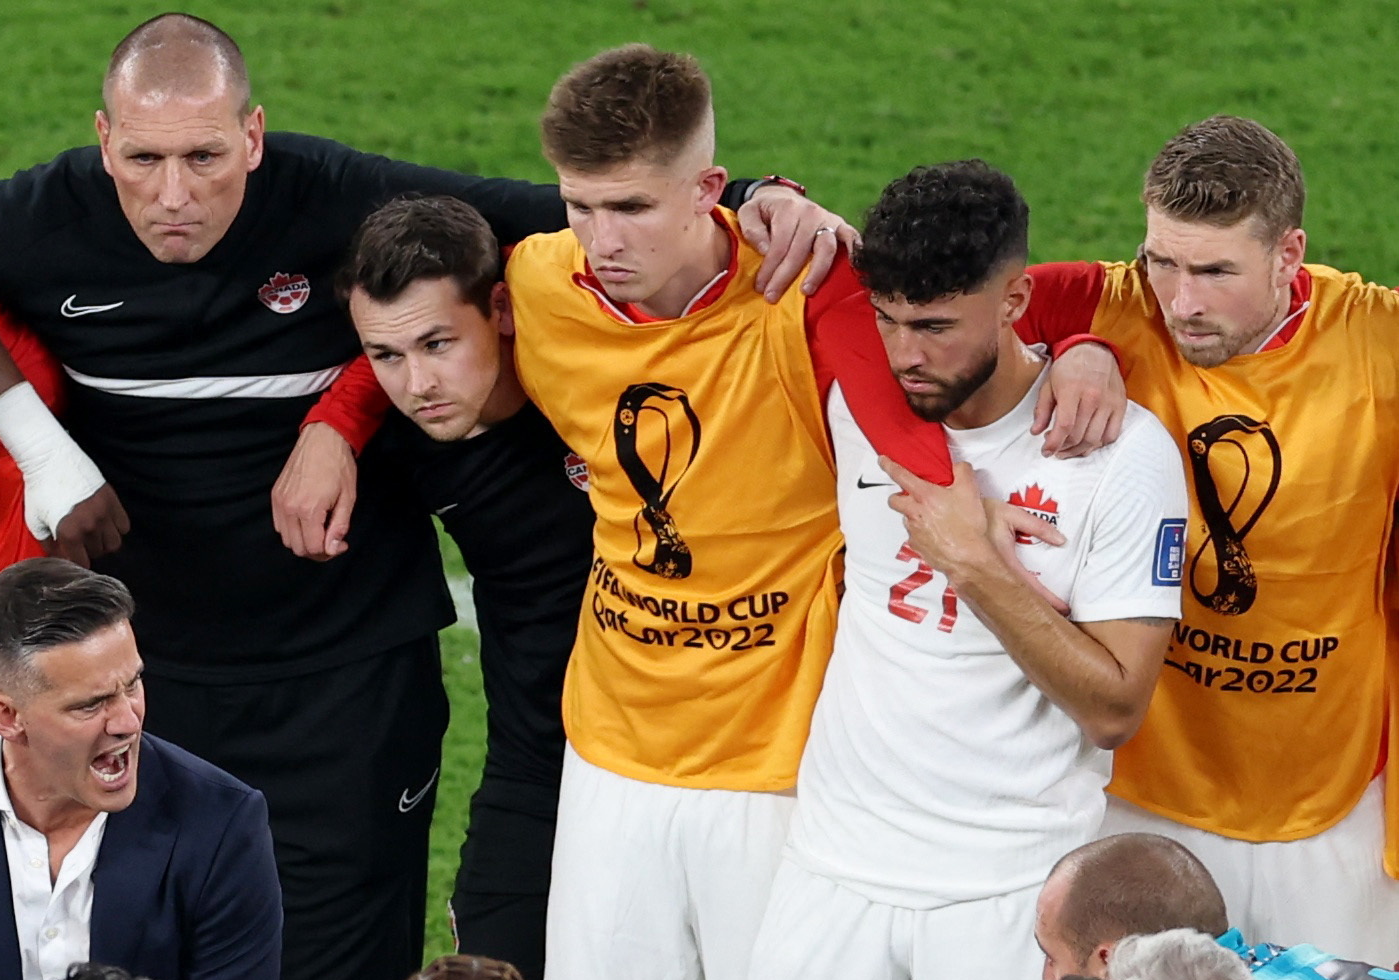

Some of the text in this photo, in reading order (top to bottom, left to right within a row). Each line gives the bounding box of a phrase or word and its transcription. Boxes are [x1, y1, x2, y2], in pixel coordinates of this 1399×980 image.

[592, 591, 776, 651] Qatar2022
[622, 587, 720, 624] WORLD
[727, 591, 789, 621] CUP
[1280, 636, 1339, 663] CUP
[1163, 658, 1318, 693] ar2022
